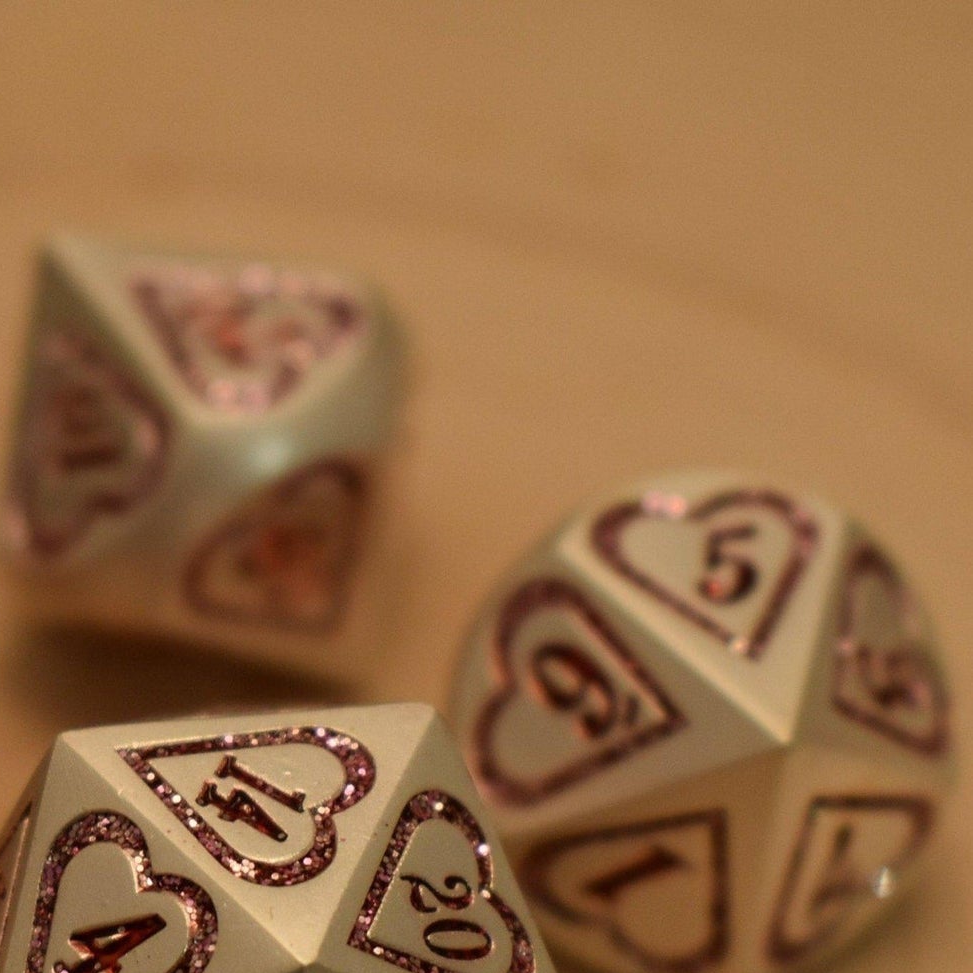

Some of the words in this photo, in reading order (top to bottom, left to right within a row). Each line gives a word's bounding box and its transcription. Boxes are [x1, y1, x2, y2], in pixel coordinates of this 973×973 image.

[700, 523, 758, 606] 5
[195, 754, 308, 843] 14
[585, 842, 689, 898] 1
[400, 874, 494, 962] 20
